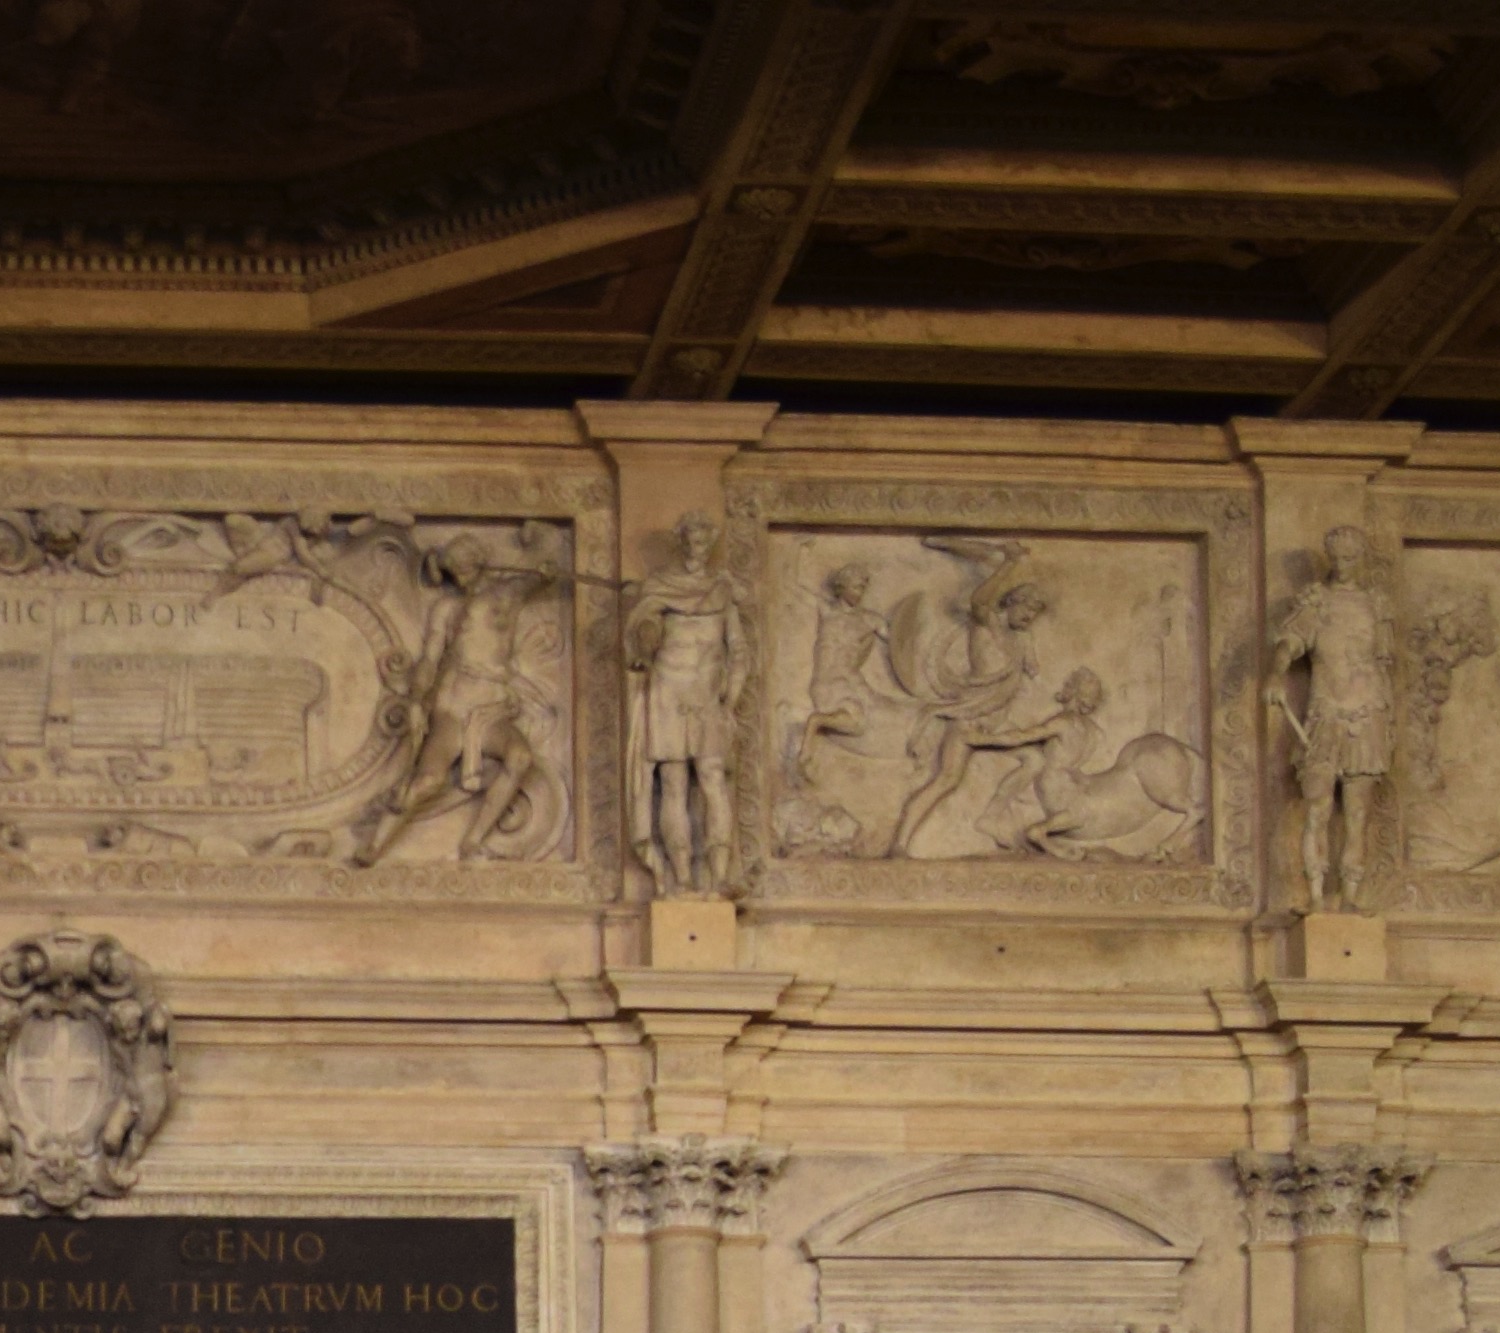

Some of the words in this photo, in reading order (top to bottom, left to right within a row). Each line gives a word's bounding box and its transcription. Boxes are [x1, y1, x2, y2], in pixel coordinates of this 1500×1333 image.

[80, 600, 198, 627] LABOR
[235, 604, 300, 633] EST
[29, 1228, 94, 1264] AC
[179, 1228, 327, 1265] GENIO
[160, 1281, 384, 1313] THEATRVM
[402, 1282, 500, 1314] HOC
